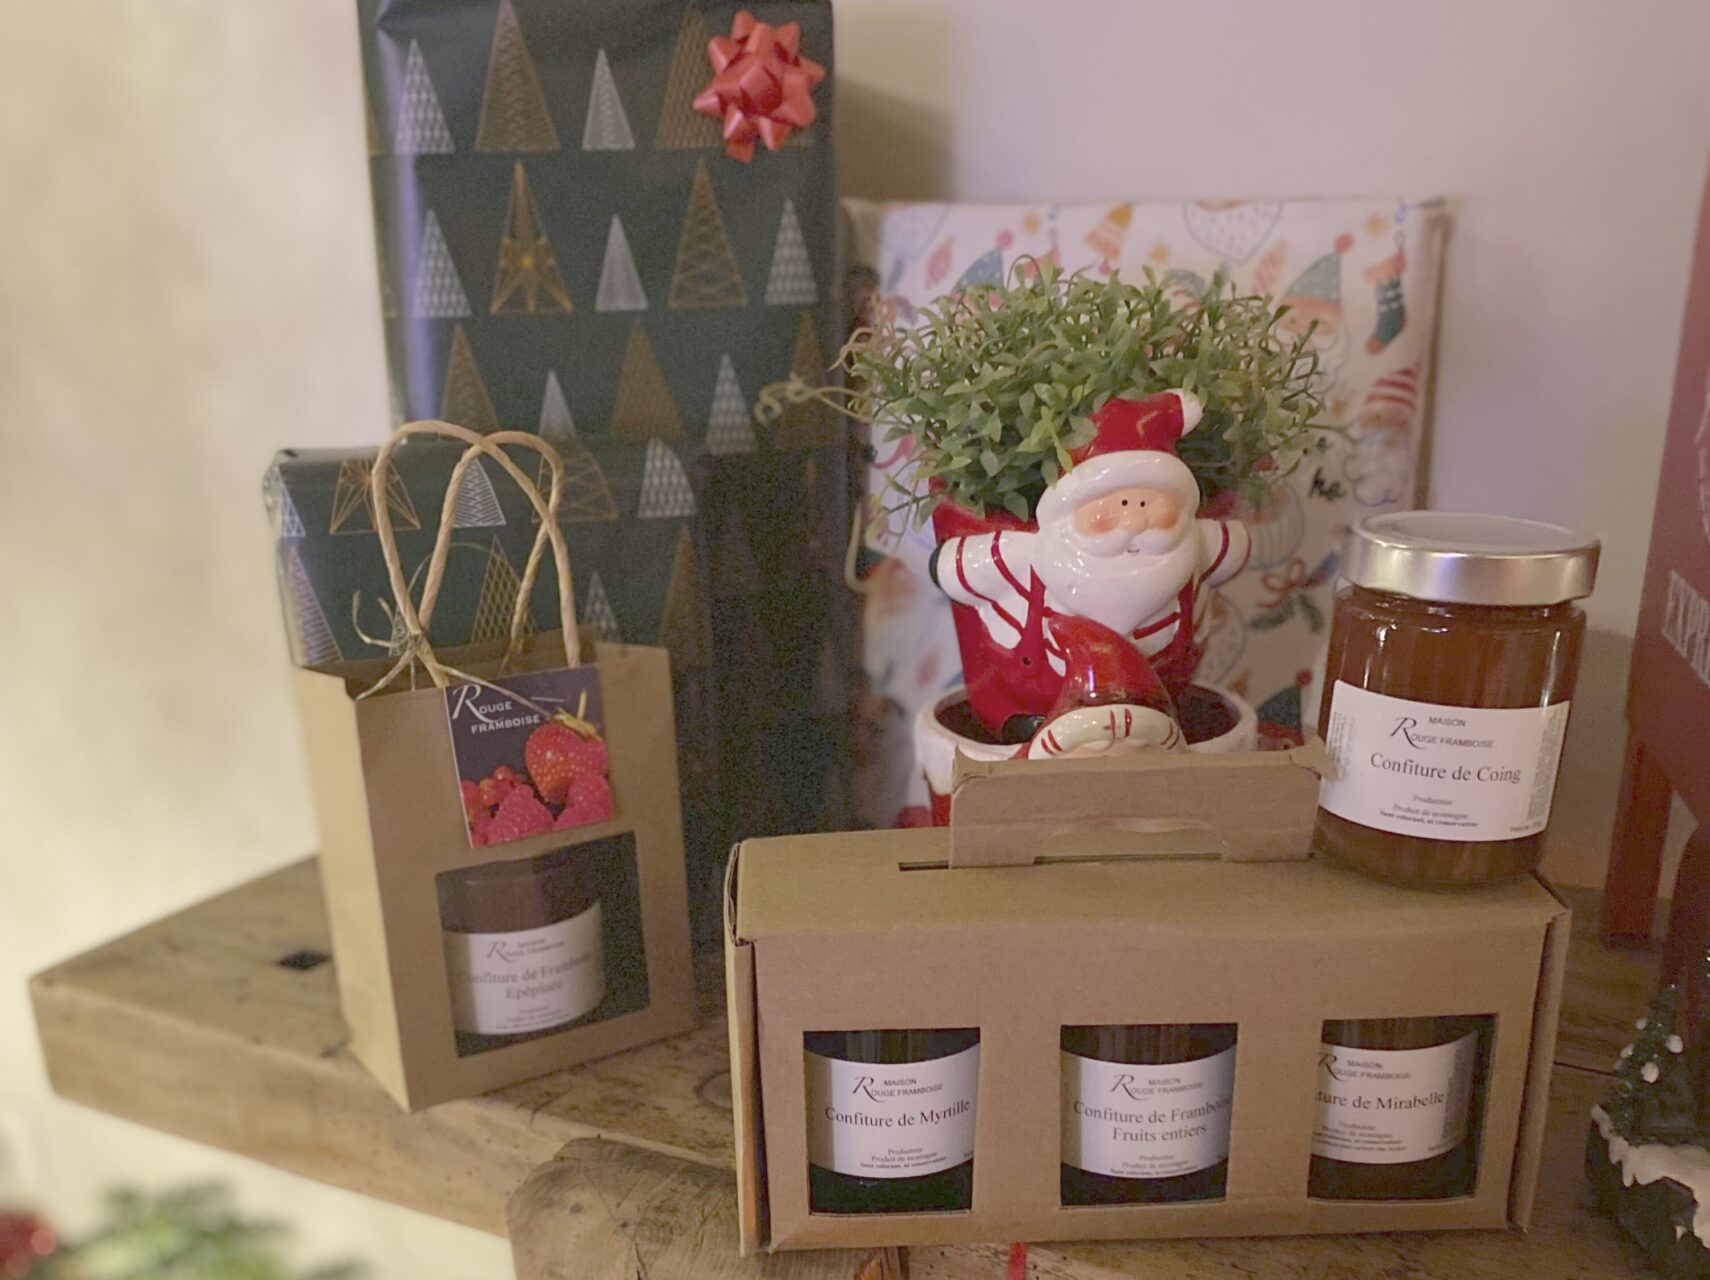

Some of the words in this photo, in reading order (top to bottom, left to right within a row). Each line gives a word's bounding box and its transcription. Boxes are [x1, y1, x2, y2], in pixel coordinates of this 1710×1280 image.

[452, 684, 512, 724] ROUGE
[471, 715, 541, 734] FRAMBOISE
[1429, 716, 1466, 727] MAISON
[1390, 717, 1437, 749] ROUGE
[1440, 737, 1494, 748] FRAMBOISE
[1370, 752, 1446, 779] Confiture
[1452, 766, 1471, 780] de
[1477, 766, 1521, 784] Coing
[523, 969, 538, 980] de
[853, 1076, 895, 1102] ROUGE
[897, 1084, 943, 1096] FRAMBOISE
[884, 1078, 917, 1086] MAISON
[1353, 1097, 1371, 1109] de
[1376, 1091, 1444, 1110] Mirabelle
[826, 1107, 892, 1127] Confiture
[898, 1114, 915, 1126] de
[921, 1100, 970, 1125] Myrtille
[1074, 1101, 1144, 1123] Confiture
[1149, 1111, 1166, 1123] de
[1113, 1127, 1157, 1142] Fruits
[1162, 1125, 1207, 1141] entiers
